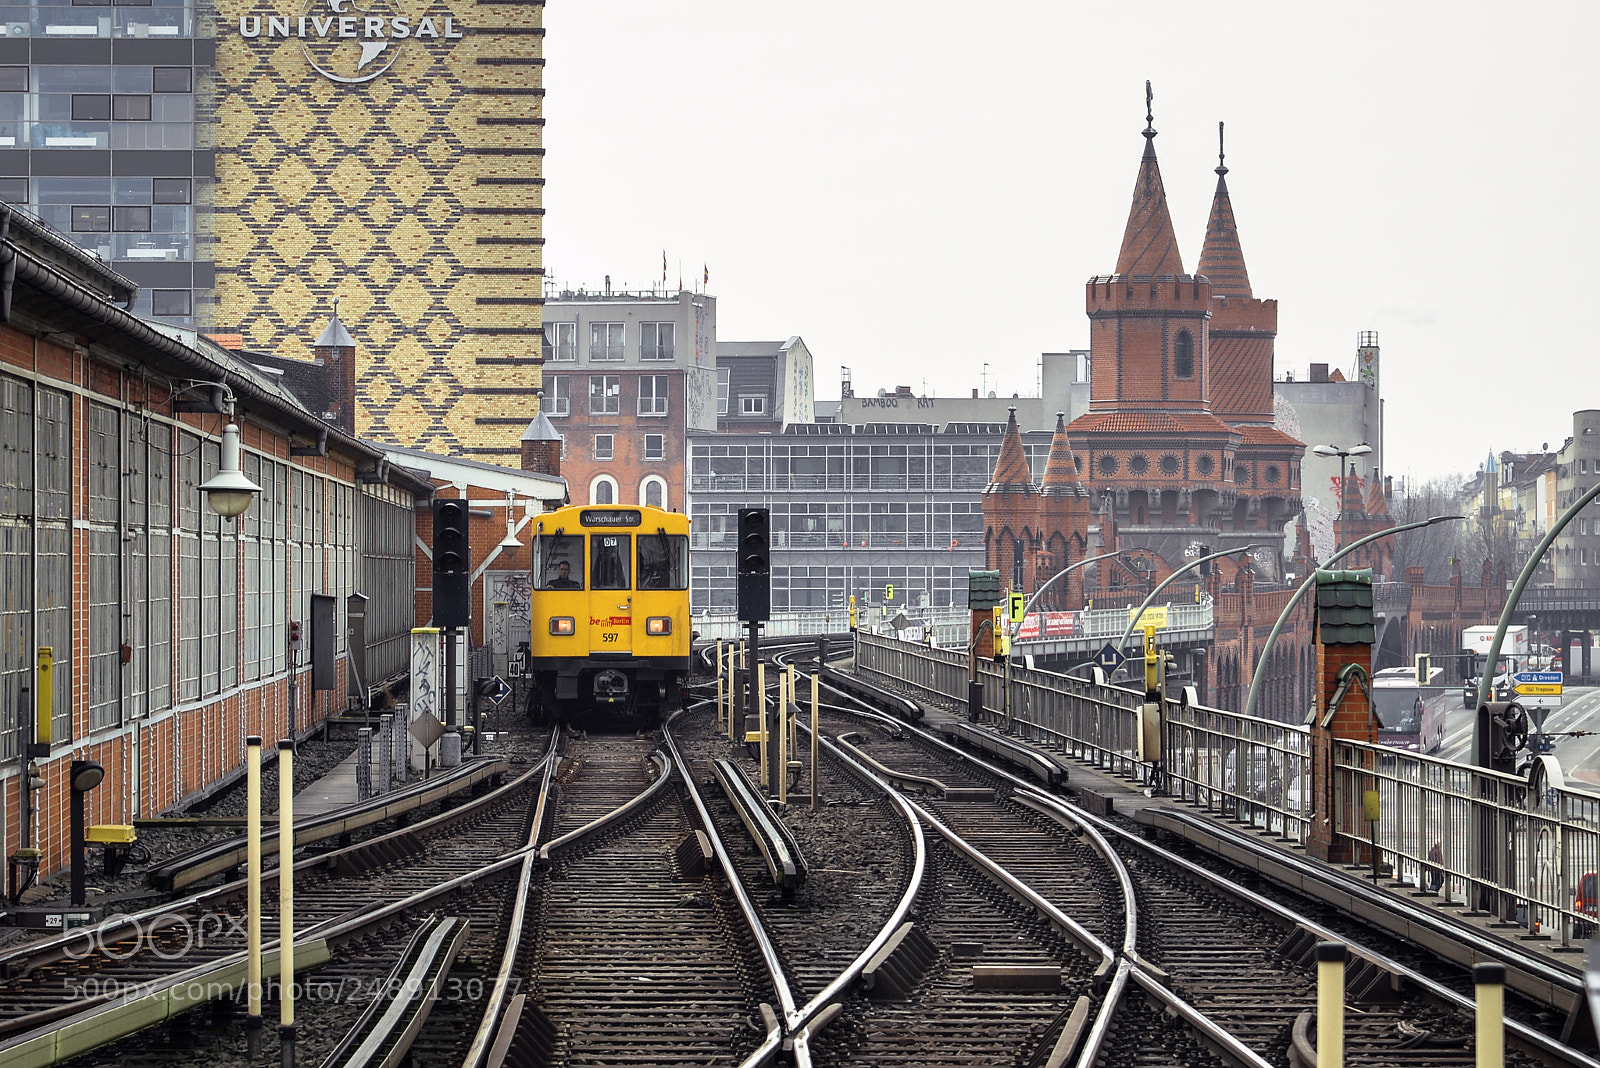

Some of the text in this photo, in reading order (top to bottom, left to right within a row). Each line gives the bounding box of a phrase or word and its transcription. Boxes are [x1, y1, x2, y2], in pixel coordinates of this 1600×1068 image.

[239, 16, 463, 39] UNIVERSAL
[861, 398, 898, 408] BAMBOO
[585, 515, 622, 523] Warschauer
[1011, 596, 1022, 619] F
[602, 632, 619, 643] 597
[509, 663, 519, 676] 40
[49, 917, 58, 925] 29
